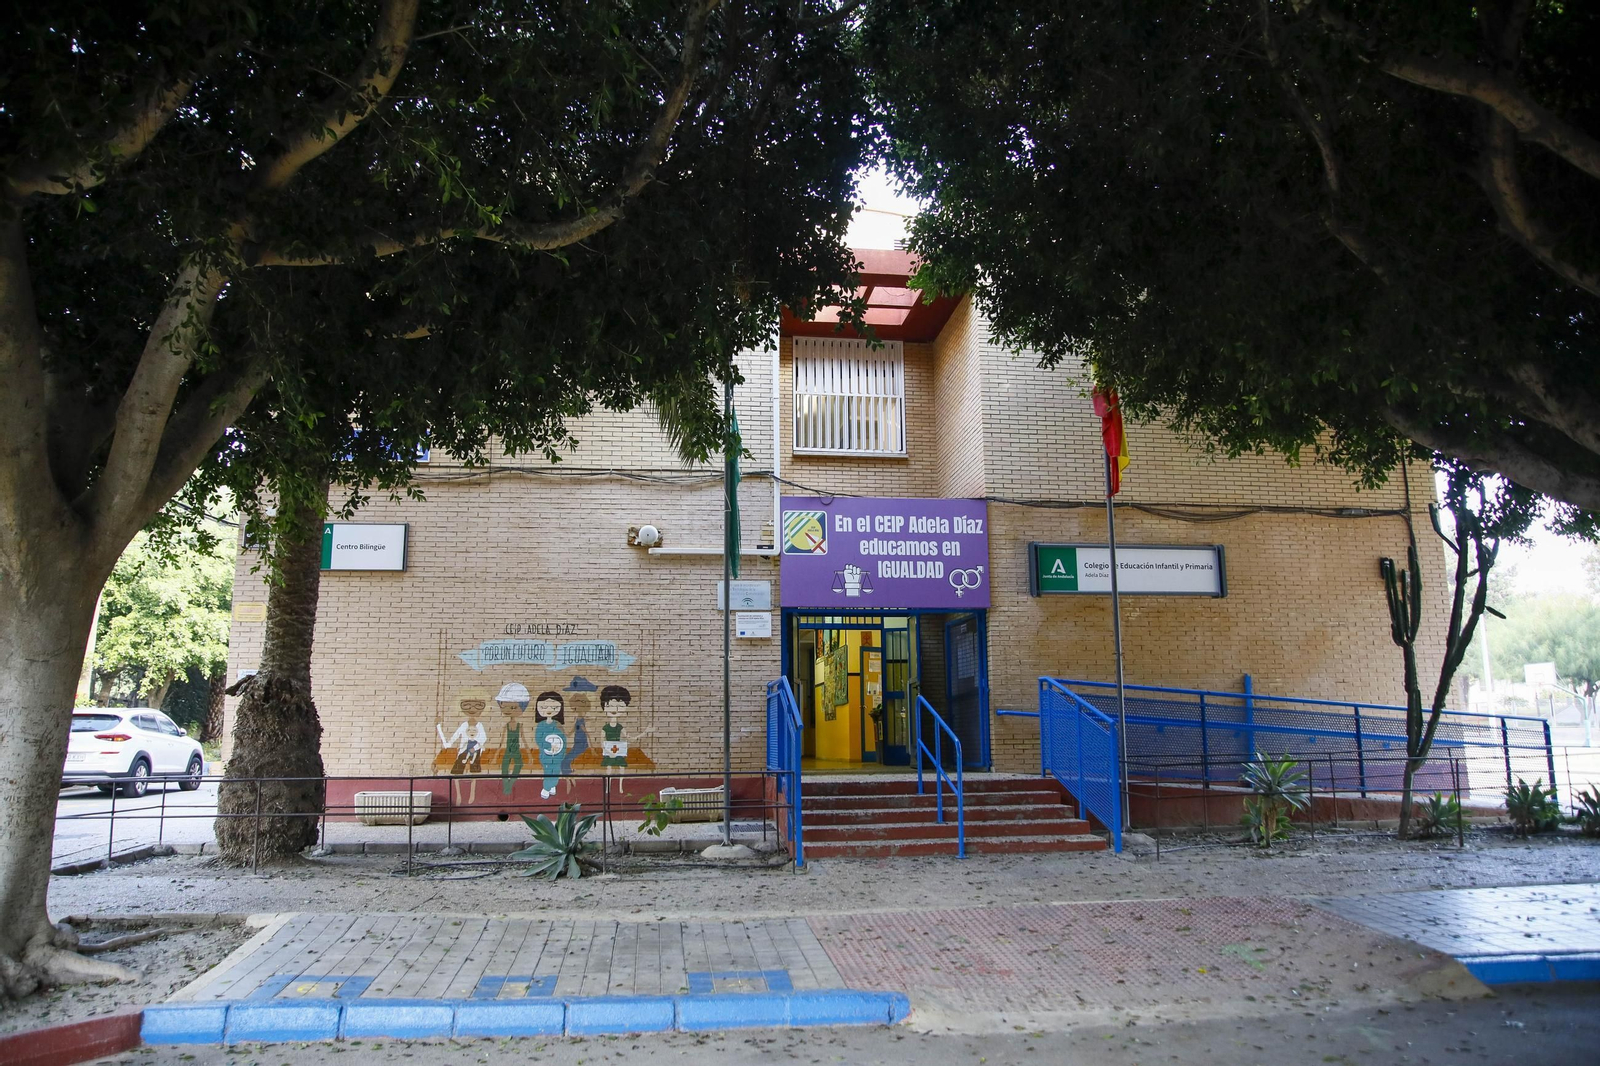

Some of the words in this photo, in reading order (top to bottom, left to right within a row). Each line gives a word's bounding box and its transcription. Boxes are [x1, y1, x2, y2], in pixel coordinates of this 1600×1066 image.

[835, 514, 852, 533] En
[856, 515, 870, 533] el
[874, 515, 905, 533] CEIP
[909, 516, 950, 534] Adela
[953, 514, 984, 534] Díaz
[359, 543, 386, 551] Bilingüe
[859, 538, 938, 556] educamos
[942, 541, 961, 556] en
[877, 560, 944, 579] IGUALDAD
[1083, 562, 1110, 571] Colegio
[1120, 561, 1154, 570] Educación
[1155, 562, 1179, 570] Infantil
[1185, 562, 1213, 570] Primaria
[526, 623, 551, 635] ADELA
